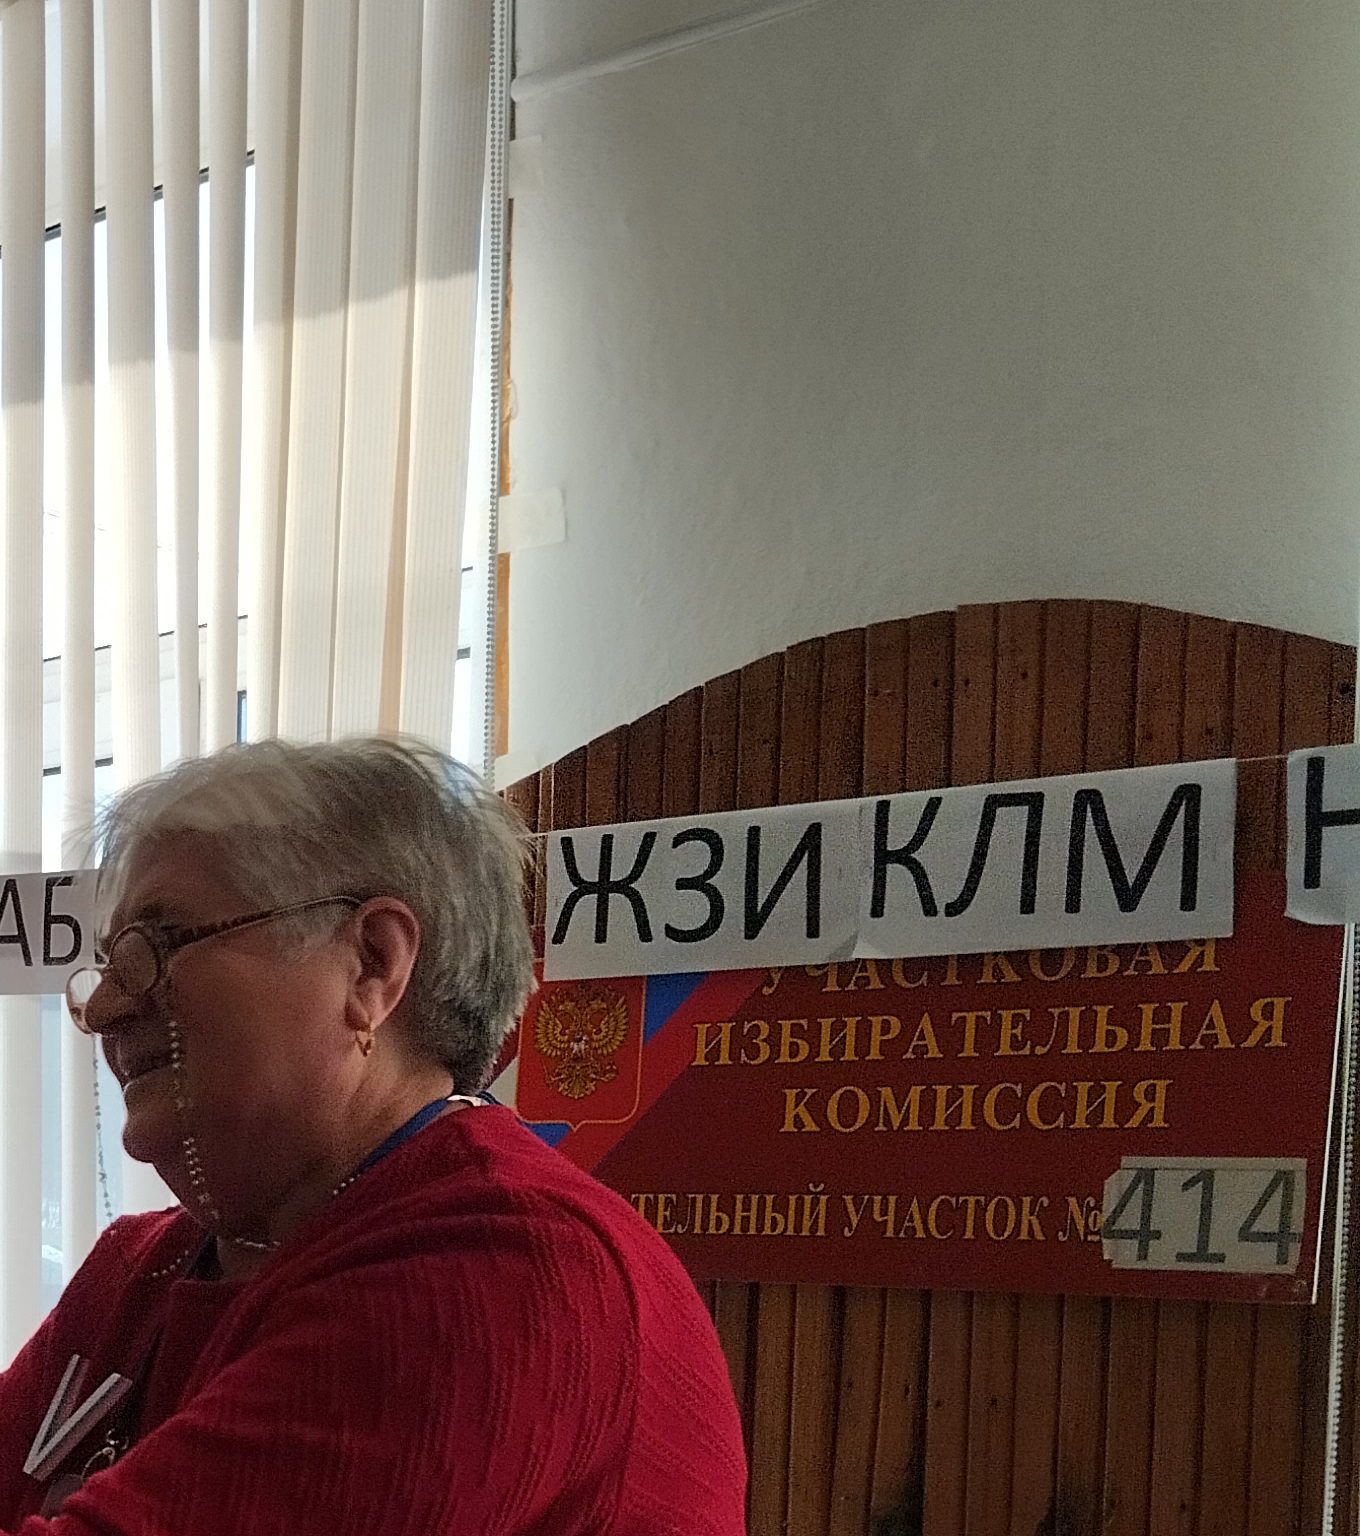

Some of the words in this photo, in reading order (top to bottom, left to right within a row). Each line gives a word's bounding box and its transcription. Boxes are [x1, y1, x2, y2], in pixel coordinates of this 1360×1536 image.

[551, 821, 822, 945] ЖЗИ
[869, 782, 1202, 919] КЛМ
[690, 996, 1292, 1067] ИЗБИРАТЕЛЬНАЯ
[778, 1078, 1174, 1134] КОМИССИЯ
[841, 1194, 1049, 1241] УЧАСТОК
[1102, 1168, 1300, 1265] 414
